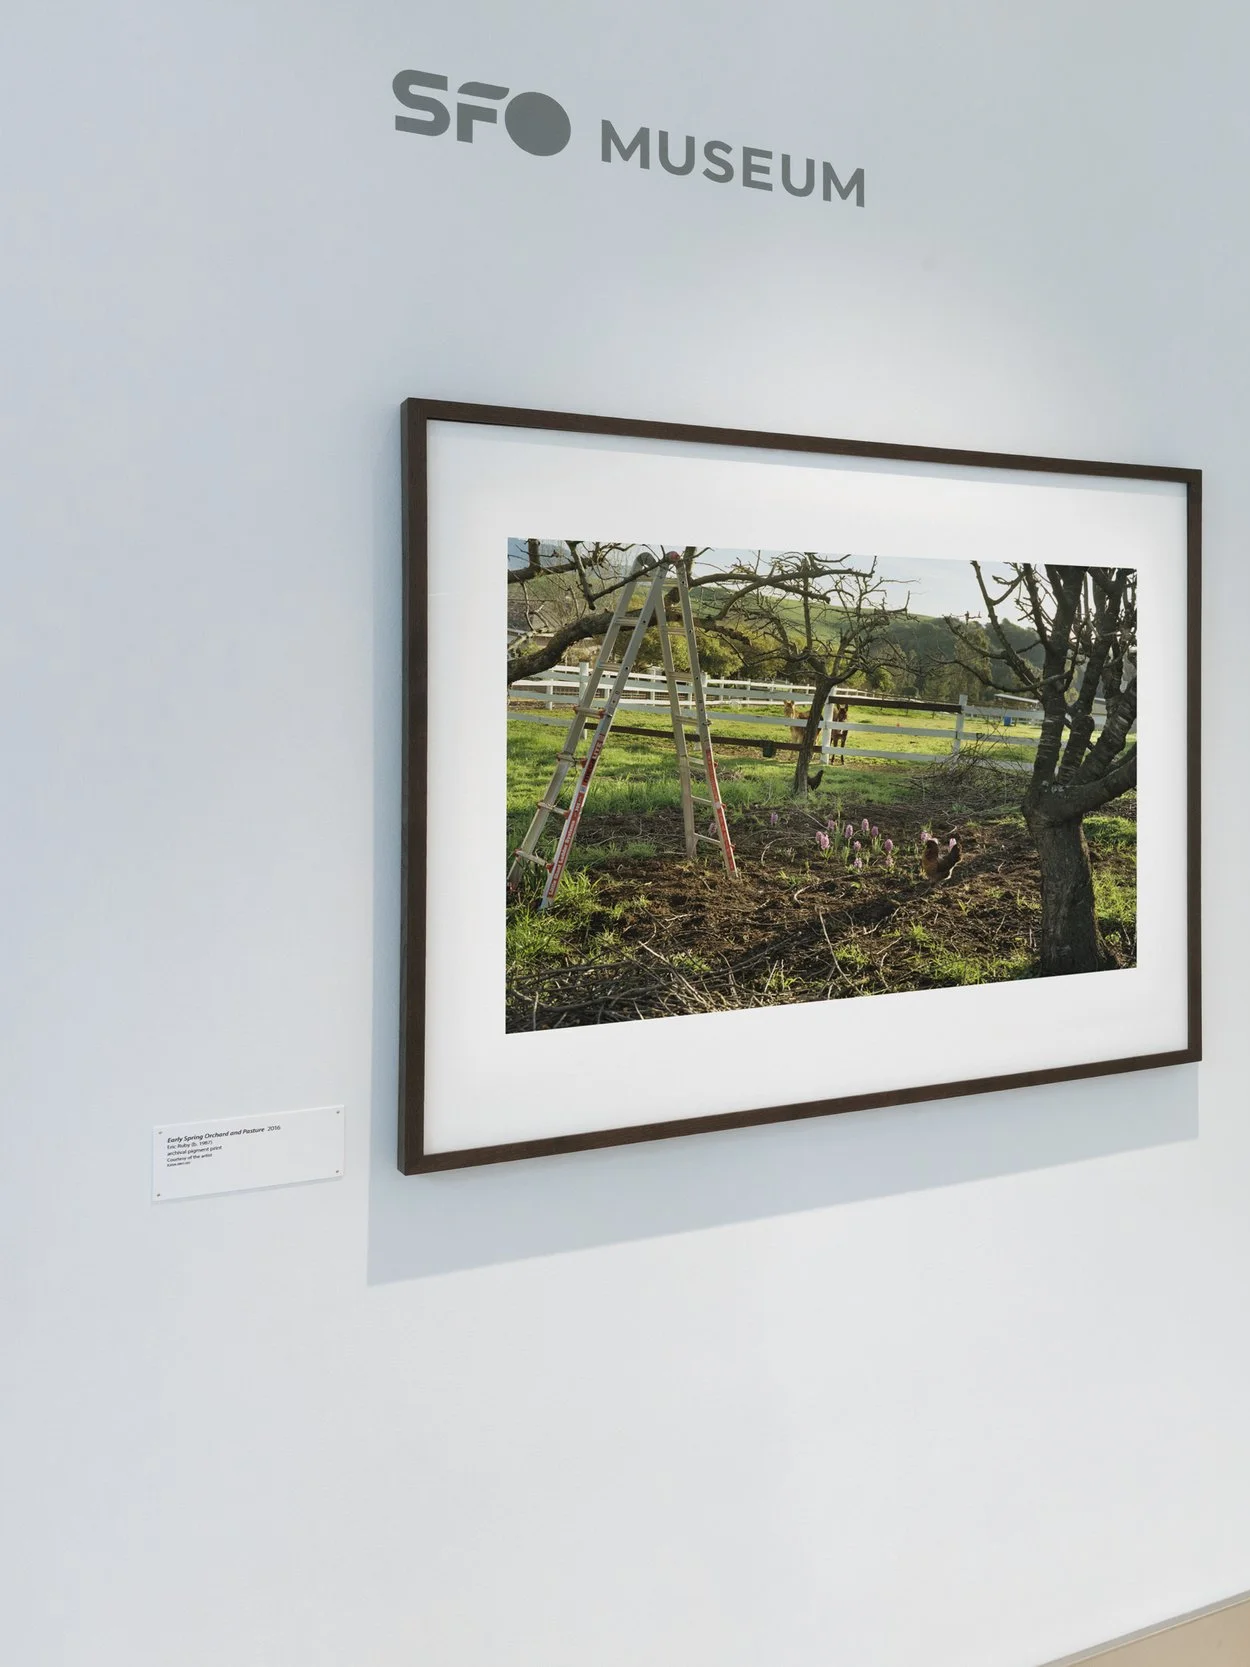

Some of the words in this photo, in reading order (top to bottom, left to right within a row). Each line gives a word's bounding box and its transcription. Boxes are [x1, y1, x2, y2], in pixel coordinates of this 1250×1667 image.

[392, 69, 572, 157] SFO
[601, 119, 865, 208] MUSEUM
[184, 1134, 204, 1142] Spring
[204, 1131, 229, 1139] Orchard
